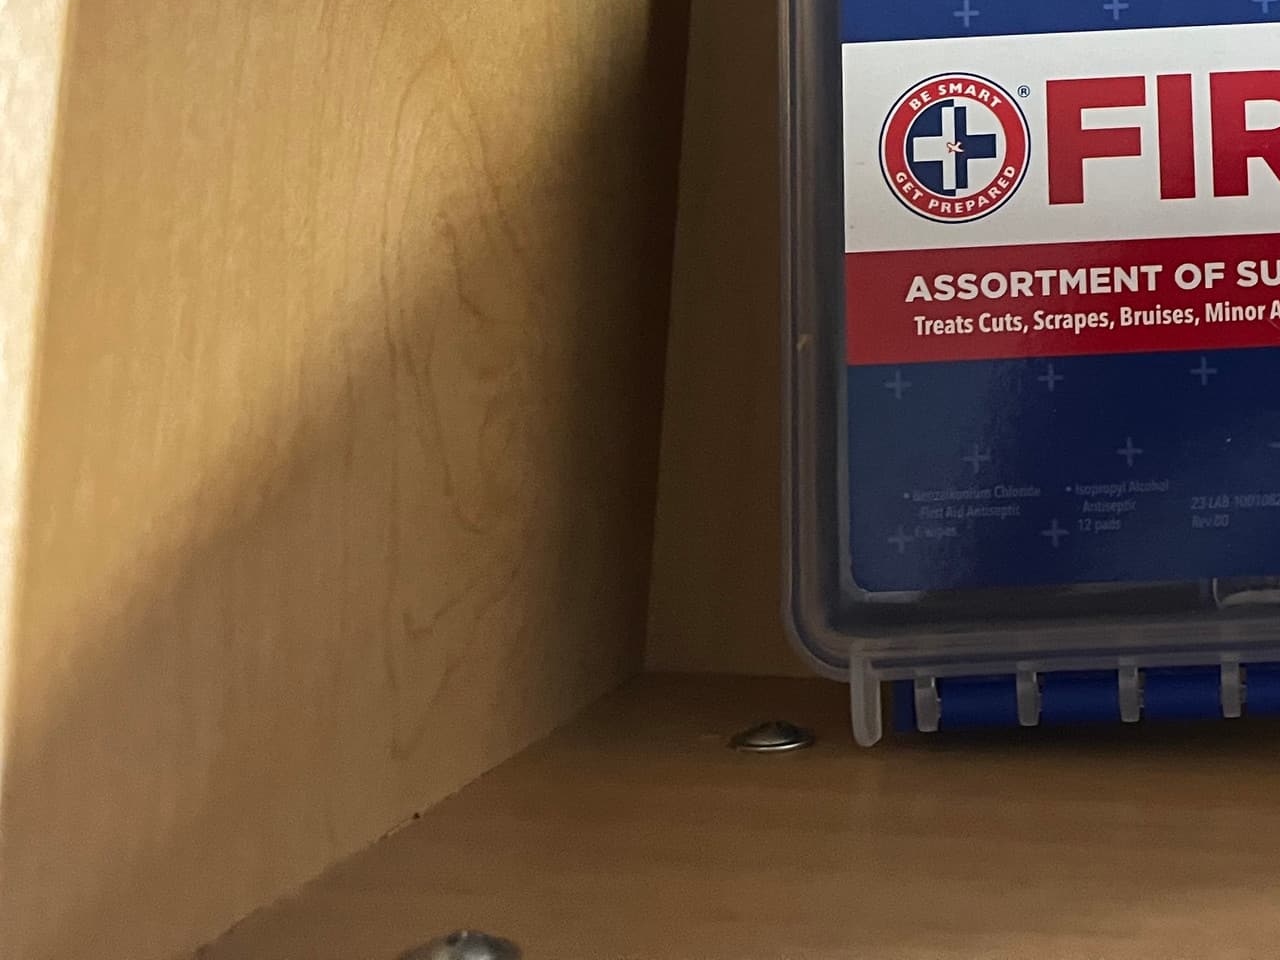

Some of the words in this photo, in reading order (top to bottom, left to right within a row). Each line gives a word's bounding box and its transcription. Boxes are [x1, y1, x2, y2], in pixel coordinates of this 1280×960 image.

[909, 91, 931, 111] BE
[938, 83, 1002, 108] SMART
[896, 172, 923, 201] GET
[929, 165, 1015, 213] PREPARED
[905, 264, 1163, 303] ASSORTMENT
[1175, 261, 1225, 289] OF
[915, 314, 974, 337] Treats
[979, 311, 1029, 335] Cuts,
[1033, 307, 1114, 333] Scrapes,
[1120, 303, 1200, 329] Bruises,
[1205, 299, 1268, 324] Minor
